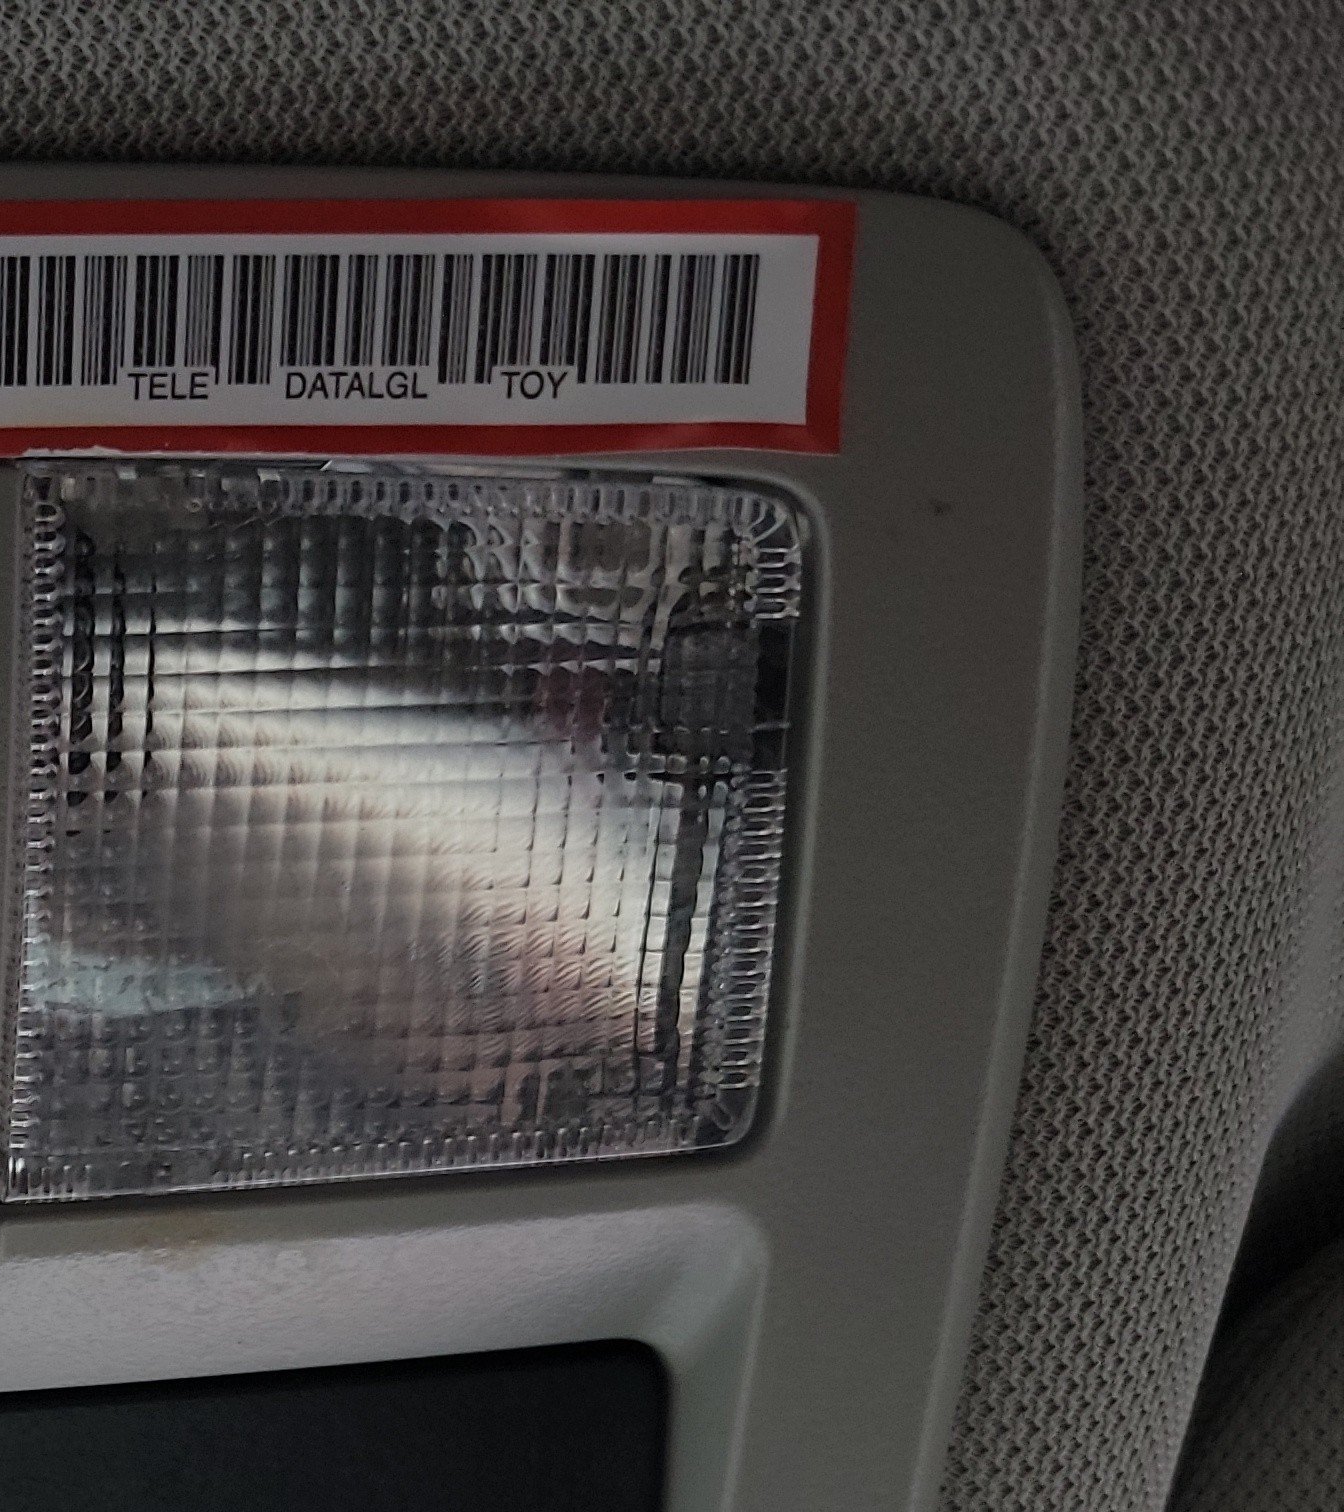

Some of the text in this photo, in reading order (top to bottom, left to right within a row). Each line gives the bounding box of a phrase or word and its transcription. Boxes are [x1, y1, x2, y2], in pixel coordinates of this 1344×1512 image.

[130, 370, 569, 402] TELE DATALGL TOY
